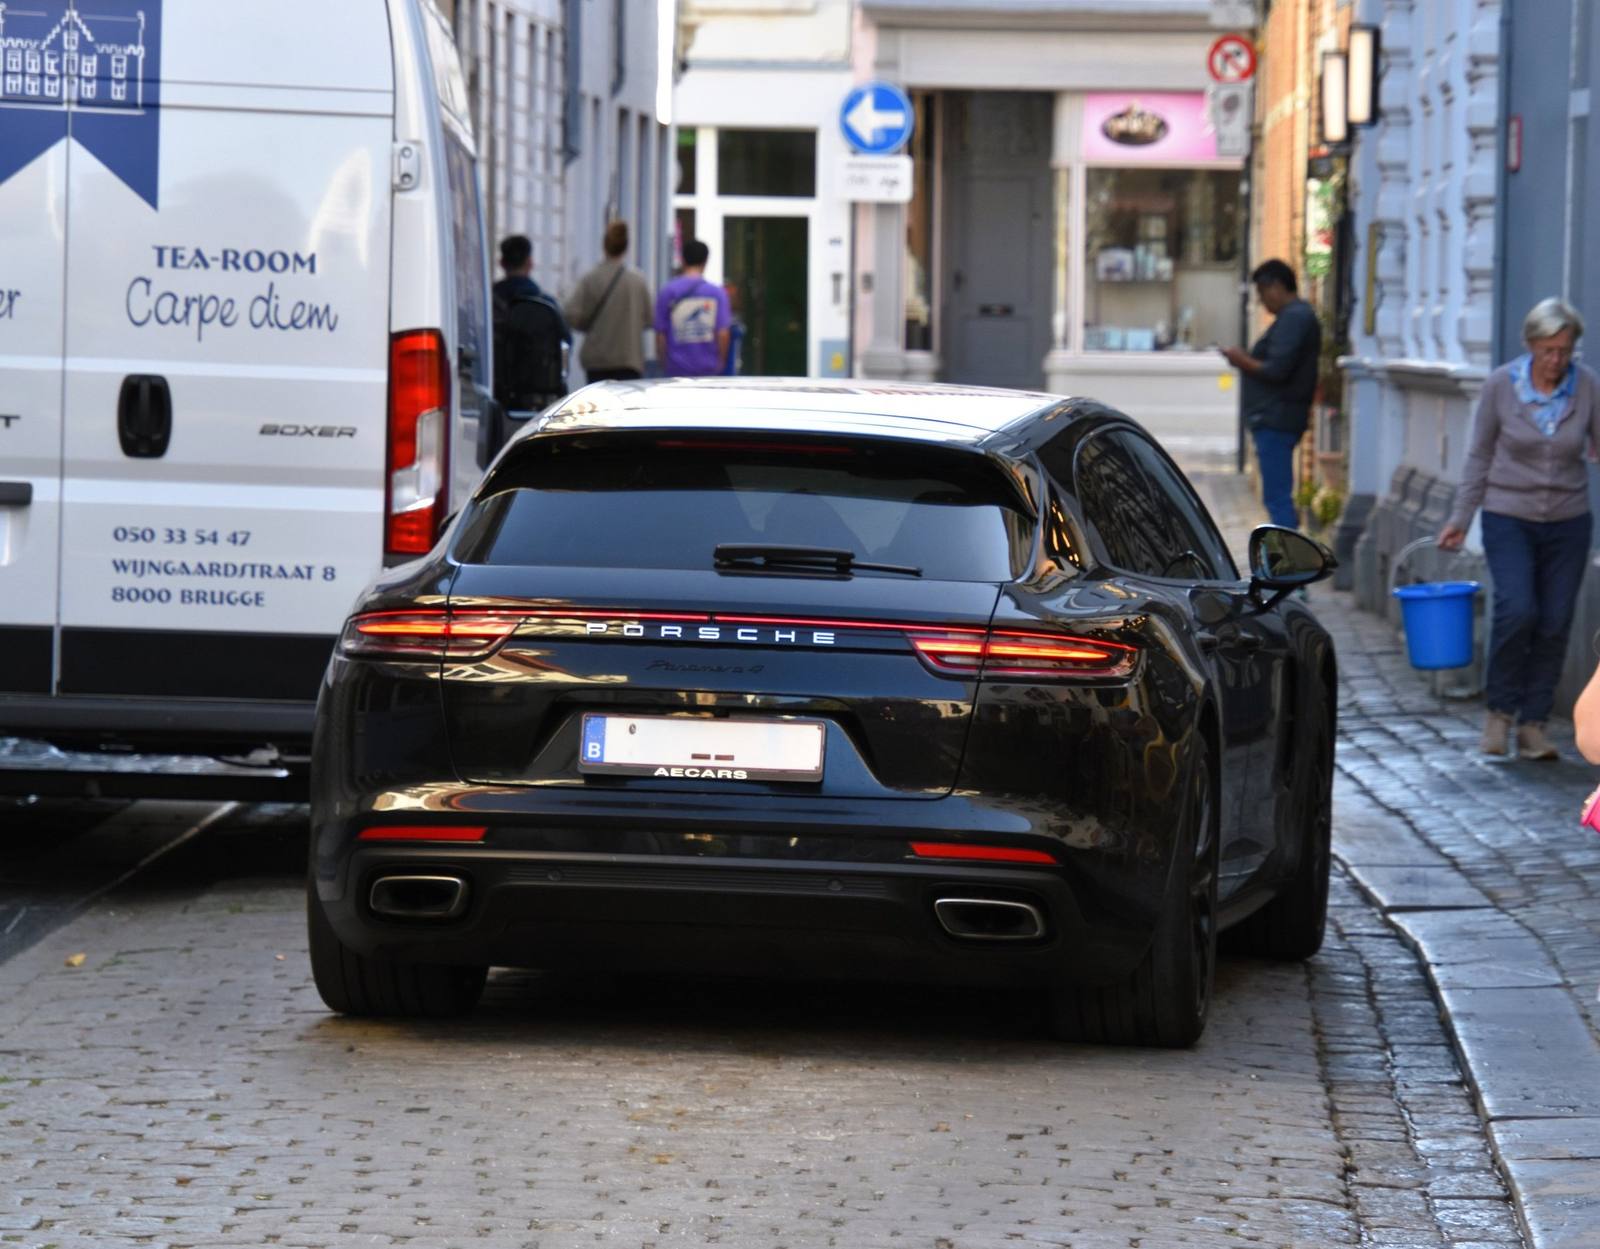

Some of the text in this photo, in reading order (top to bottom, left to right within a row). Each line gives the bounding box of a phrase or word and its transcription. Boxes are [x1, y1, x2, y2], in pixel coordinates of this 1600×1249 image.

[153, 246, 317, 275] TEA-ROOM
[126, 277, 338, 343] Carpe diem
[259, 423, 357, 438] BOXER
[113, 527, 251, 546] 050 33 54 47
[112, 559, 336, 581] WIJNGAARDSTRAAT 8
[112, 587, 265, 607] 8000 BRUGGE
[586, 623, 835, 645] PORSCHE
[587, 742, 601, 758] B
[653, 766, 748, 780] AECARS
